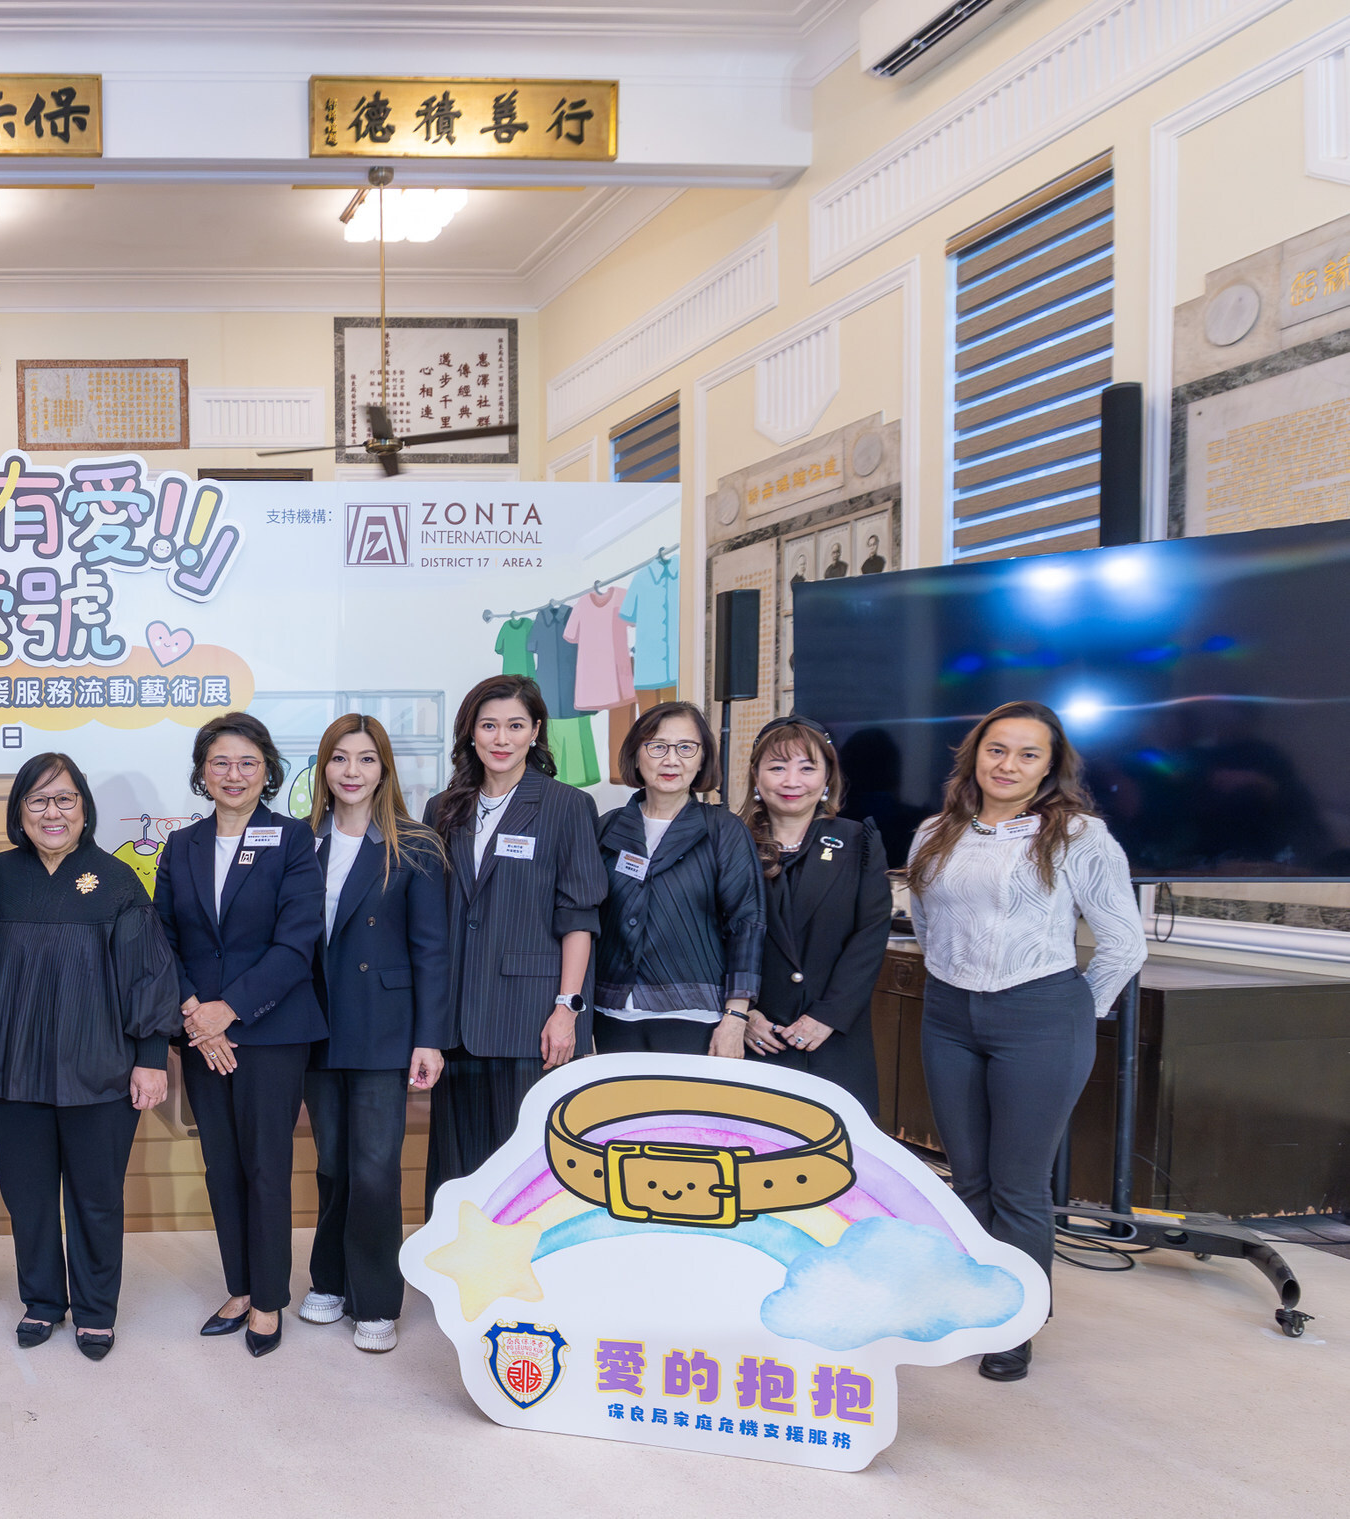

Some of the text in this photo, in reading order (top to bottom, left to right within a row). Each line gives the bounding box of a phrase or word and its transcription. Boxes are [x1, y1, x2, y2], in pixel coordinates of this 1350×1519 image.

[418, 366, 434, 419] 心相連
[421, 502, 543, 526] ZONTA
[421, 530, 543, 545] INTERNATIONAL
[421, 557, 543, 568] DISTRICT 17 AREA 2
[595, 1338, 876, 1427] 愛的抱抱
[607, 1403, 853, 1451] 保良局家庭危機支援服務
